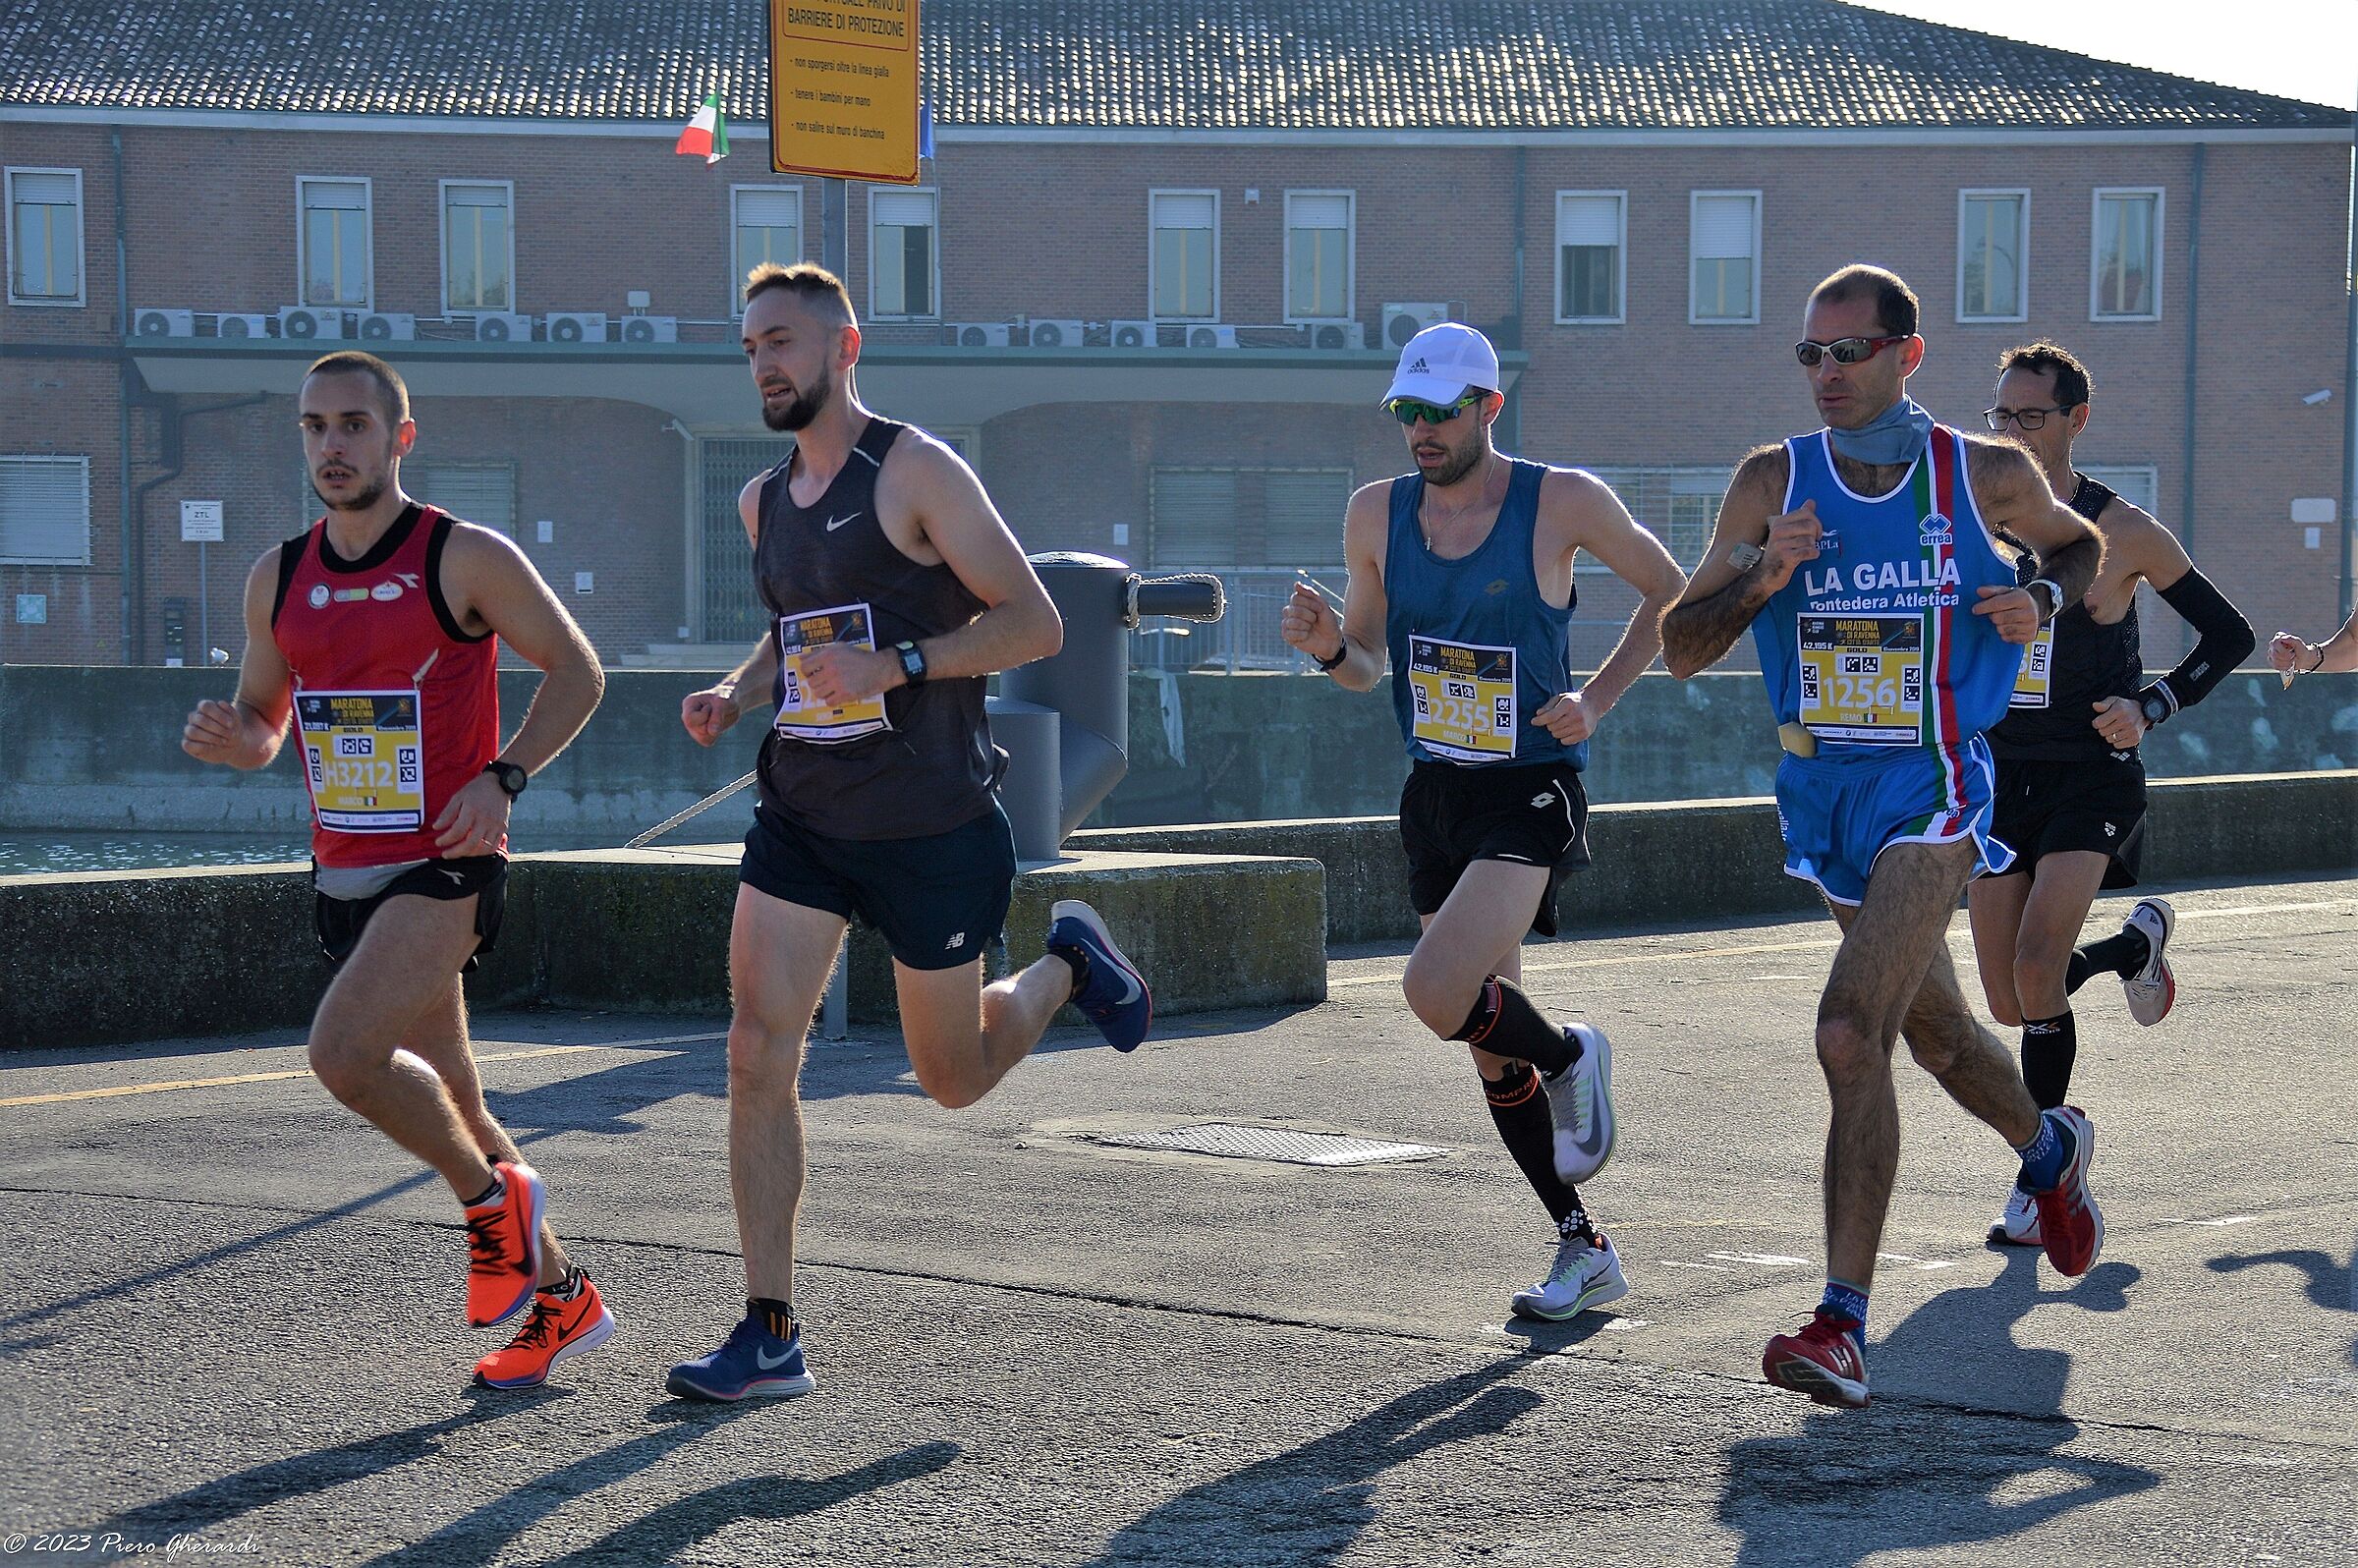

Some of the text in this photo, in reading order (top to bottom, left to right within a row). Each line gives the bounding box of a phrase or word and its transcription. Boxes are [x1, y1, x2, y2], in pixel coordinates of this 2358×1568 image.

[896, 0, 905, 12] DI
[788, 7, 904, 37] BARRIERE DI PROTEZIONE
[808, 58, 835, 73] sporgersi
[819, 89, 843, 103] bambini
[859, 126, 885, 140] banchina
[1921, 532, 1952, 544] errea
[1804, 558, 1962, 597] LA GALLA
[1893, 590, 1960, 608] Atletica
[1835, 620, 1879, 632] MARATONA
[1854, 631, 1881, 640] RAVENNA
[1440, 645, 1475, 661] MARATONA
[1803, 642, 1827, 650] 42,195
[1823, 677, 1896, 708] 1256
[330, 698, 374, 710] MARATONA
[1430, 697, 1490, 733] 2255
[324, 760, 393, 788] H3212
